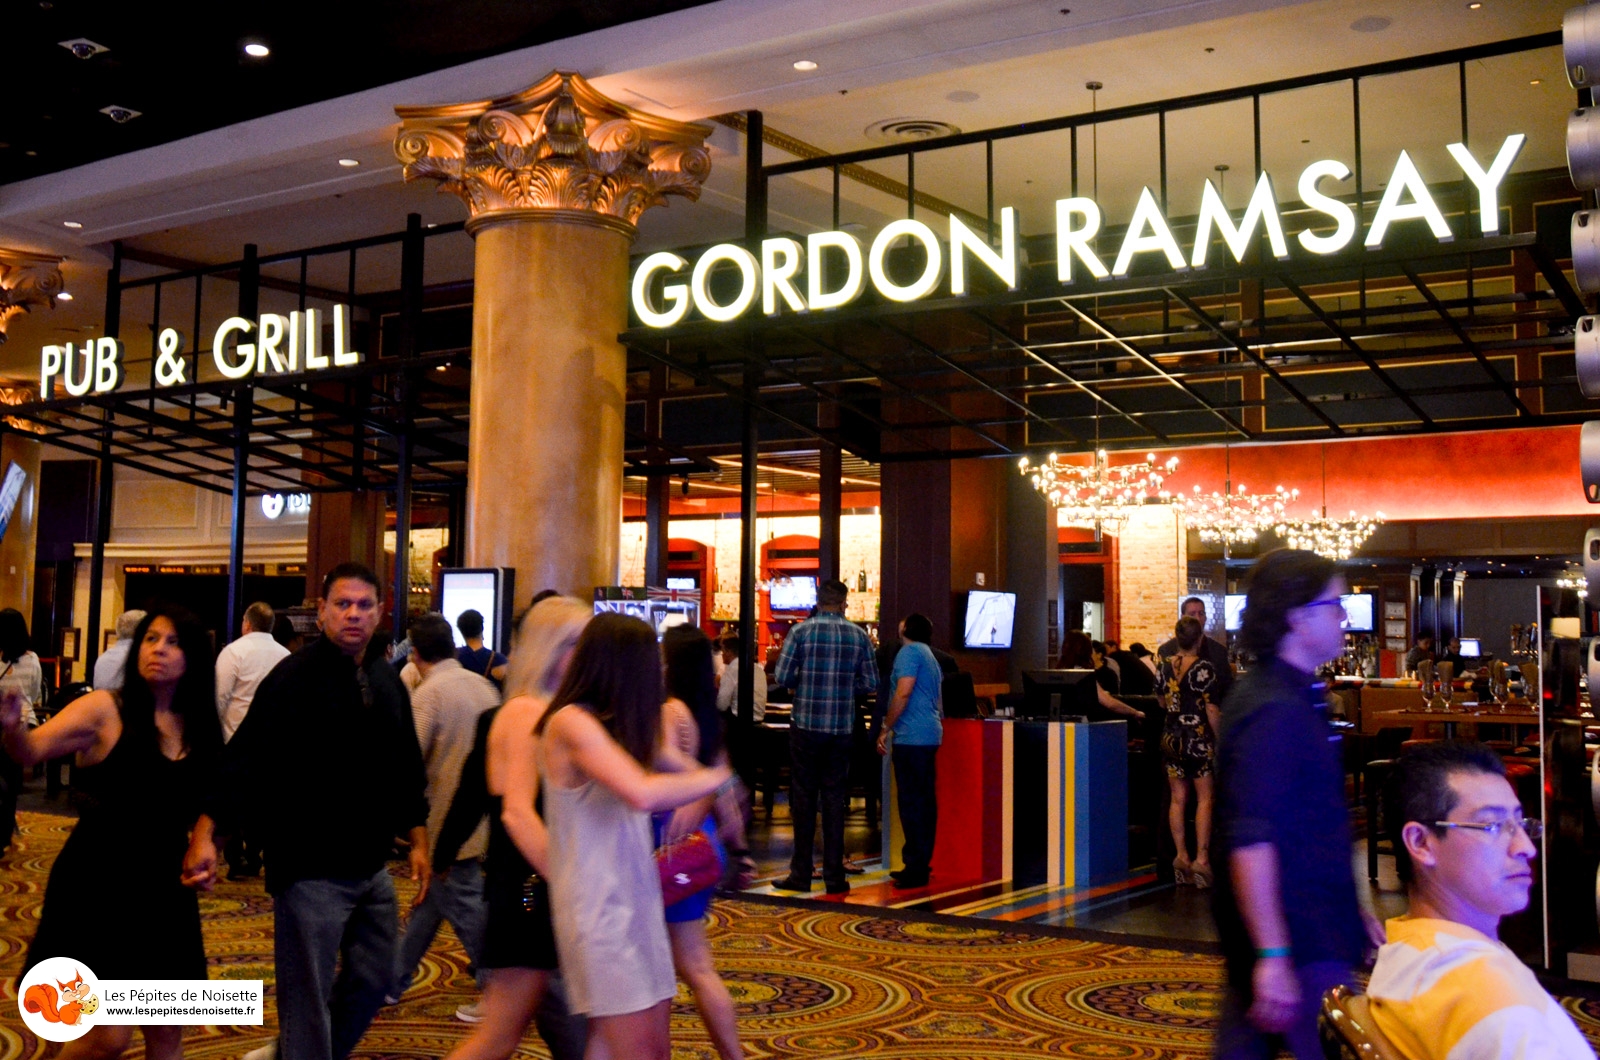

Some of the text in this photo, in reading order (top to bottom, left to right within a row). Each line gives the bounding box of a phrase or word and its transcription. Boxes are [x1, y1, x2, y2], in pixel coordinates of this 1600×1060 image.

[631, 133, 1526, 328] GORDON RAMSAY
[41, 303, 361, 398] PUB & GRILL
